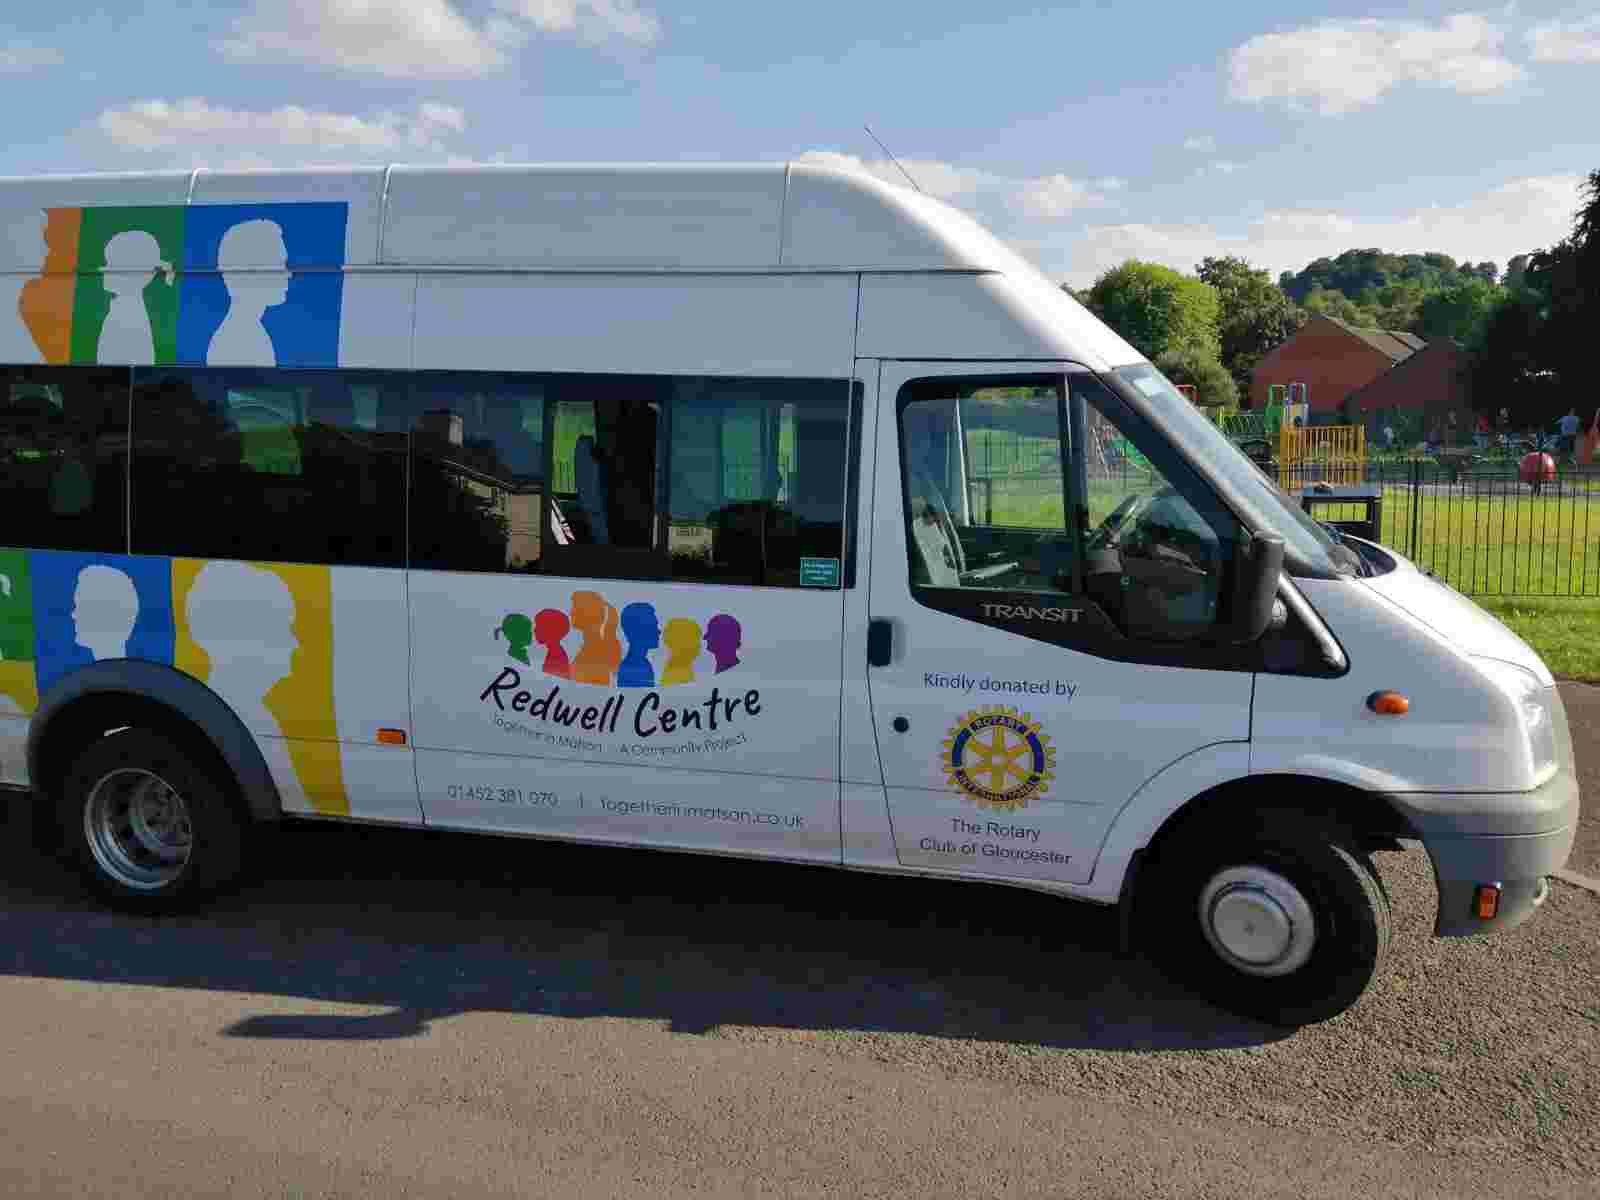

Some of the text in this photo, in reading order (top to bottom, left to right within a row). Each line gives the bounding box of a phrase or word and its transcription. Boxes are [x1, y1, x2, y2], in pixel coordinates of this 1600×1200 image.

[980, 603, 1084, 622] TRANSIT
[924, 672, 1077, 702] Kindly donated by
[480, 666, 762, 737] Redwell Centre
[447, 784, 494, 801] 01452
[496, 788, 522, 803] 381
[951, 817, 1041, 843] The Rotary
[920, 837, 1073, 864] Club of Gloucester
